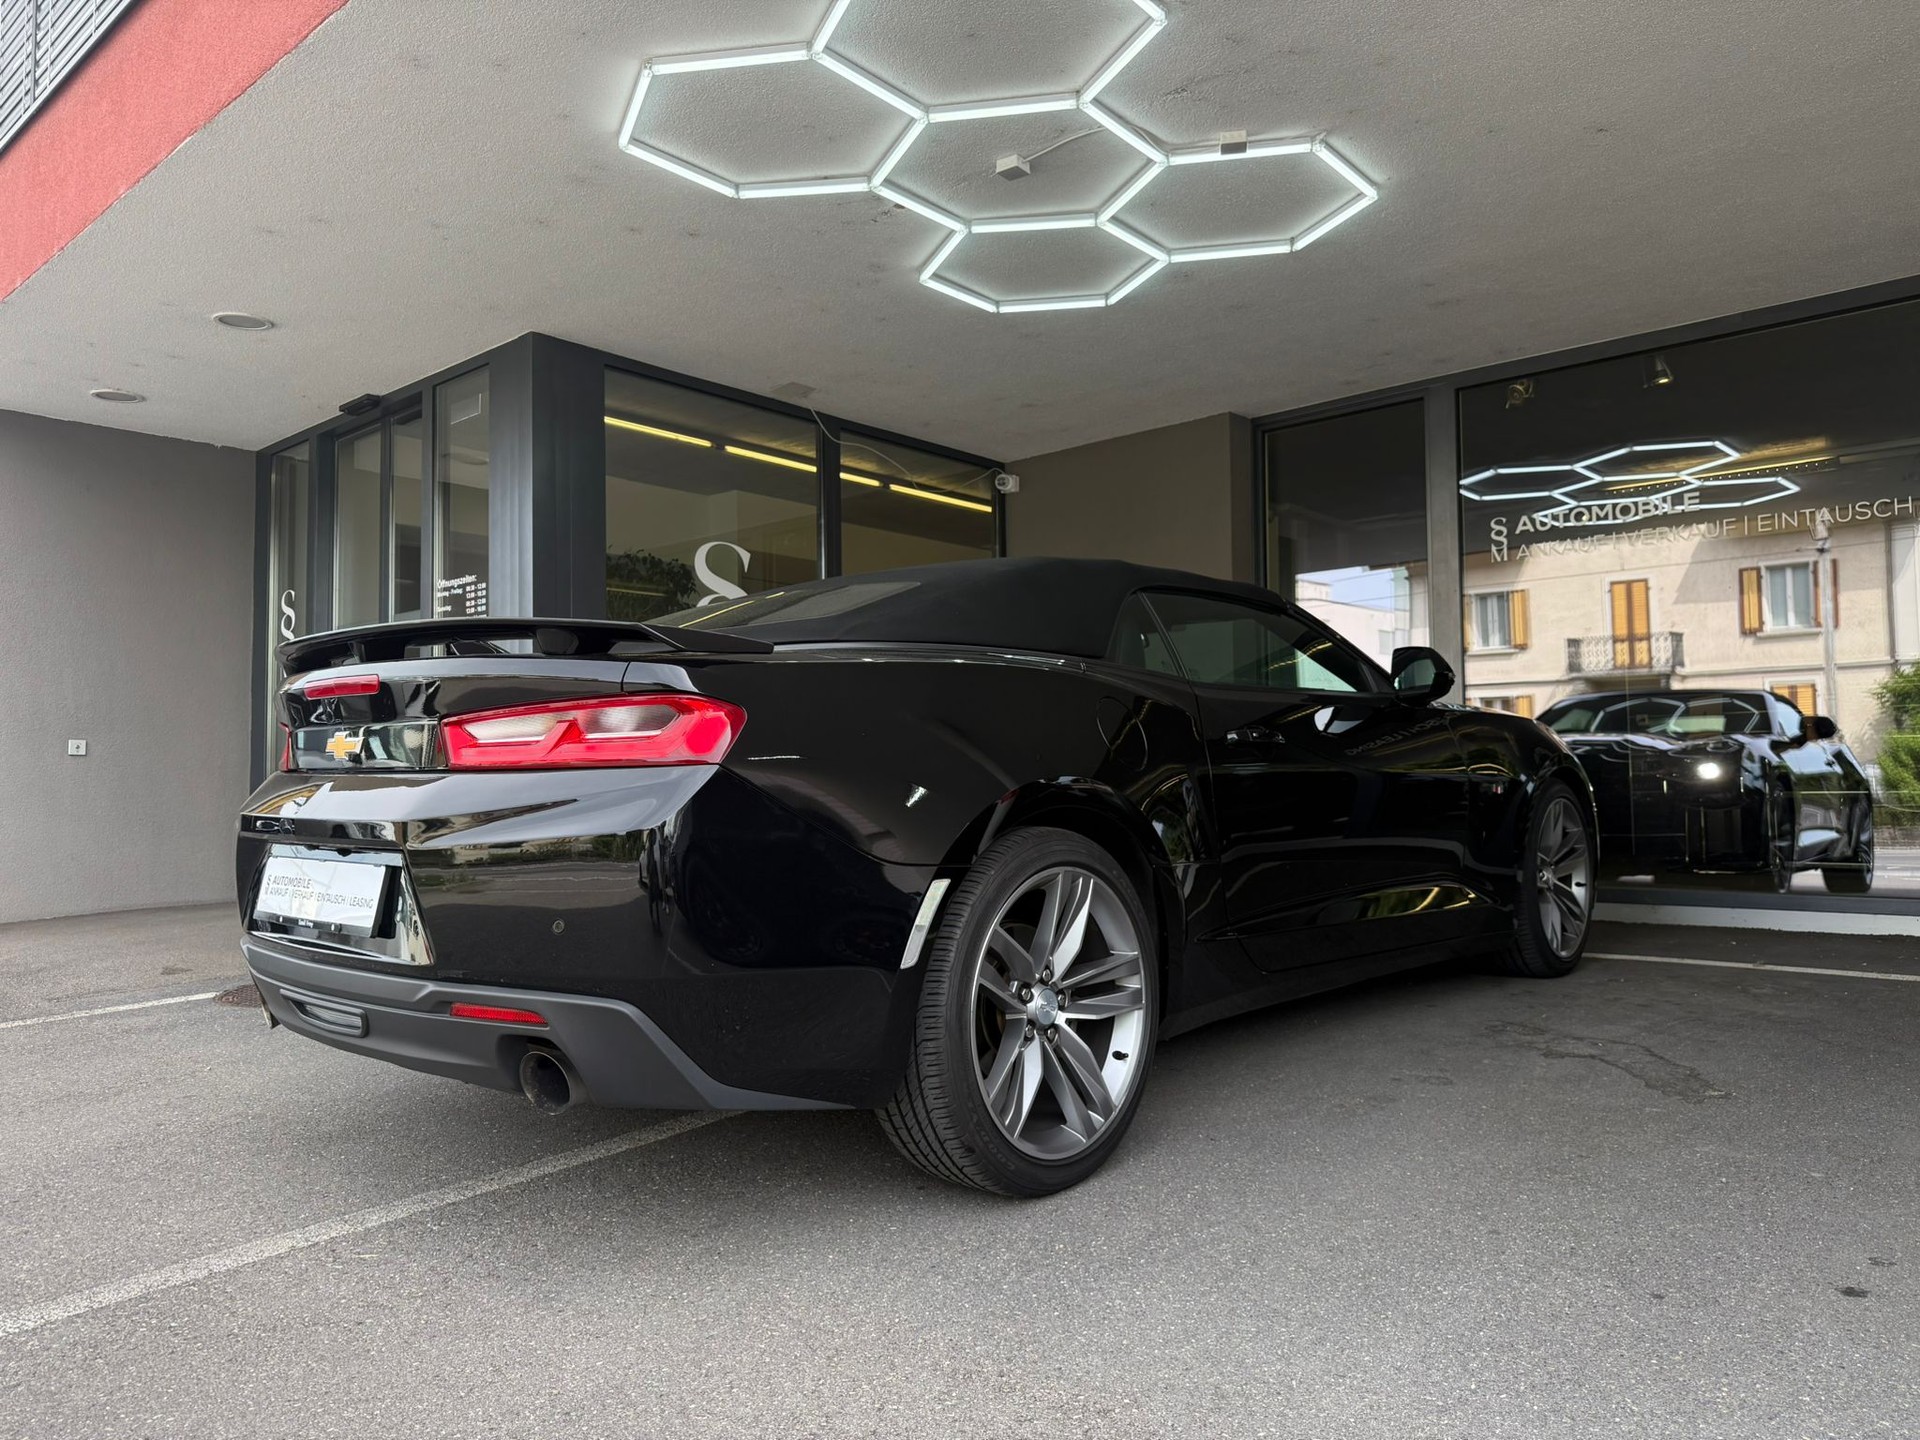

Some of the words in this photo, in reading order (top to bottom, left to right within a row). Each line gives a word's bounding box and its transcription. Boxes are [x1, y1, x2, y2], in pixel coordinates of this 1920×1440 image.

[1515, 491, 1701, 534] AUTOMOBILE
[1516, 533, 1606, 560] ANKAUF
[1620, 518, 1737, 549] VERKAUF
[1757, 495, 1912, 532] EINTAUSCH
[272, 875, 312, 889] AUTOMOBILE
